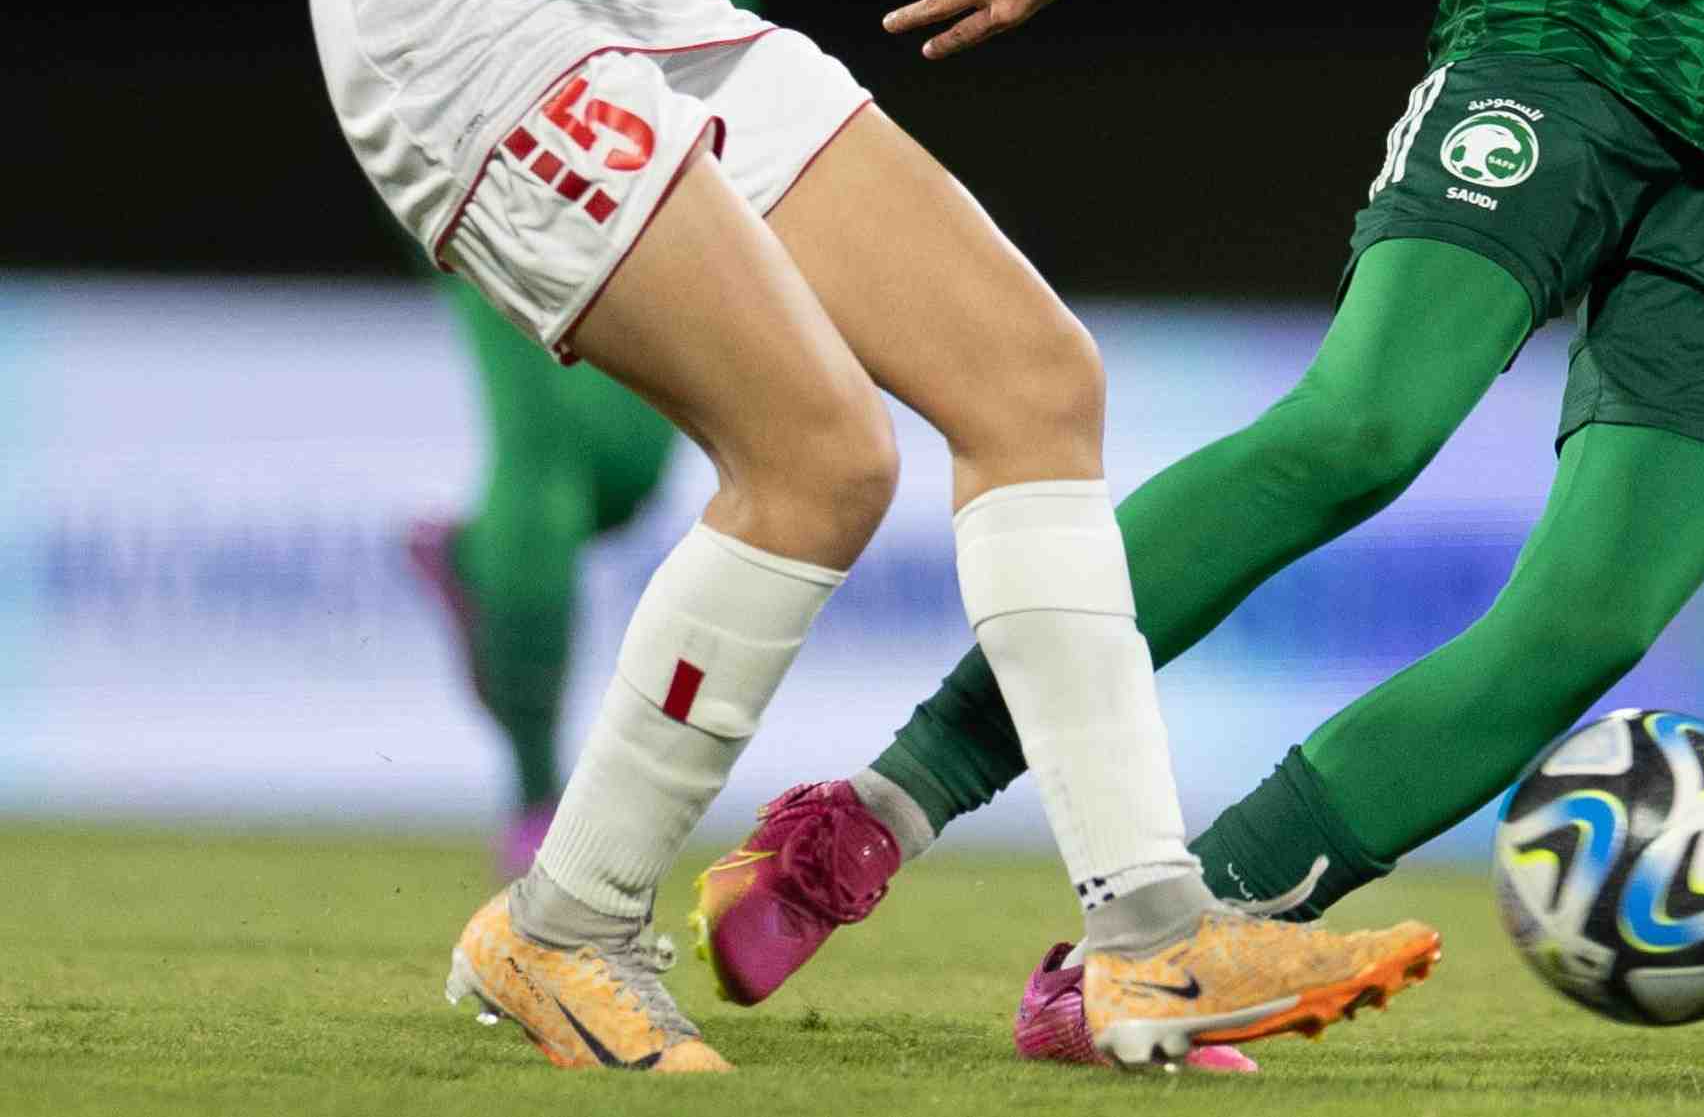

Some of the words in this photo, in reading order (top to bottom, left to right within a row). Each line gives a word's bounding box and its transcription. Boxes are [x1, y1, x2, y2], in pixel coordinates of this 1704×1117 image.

[1467, 98, 1545, 122] السعودية
[541, 75, 655, 172] 5
[1445, 186, 1498, 211] SAUDI
